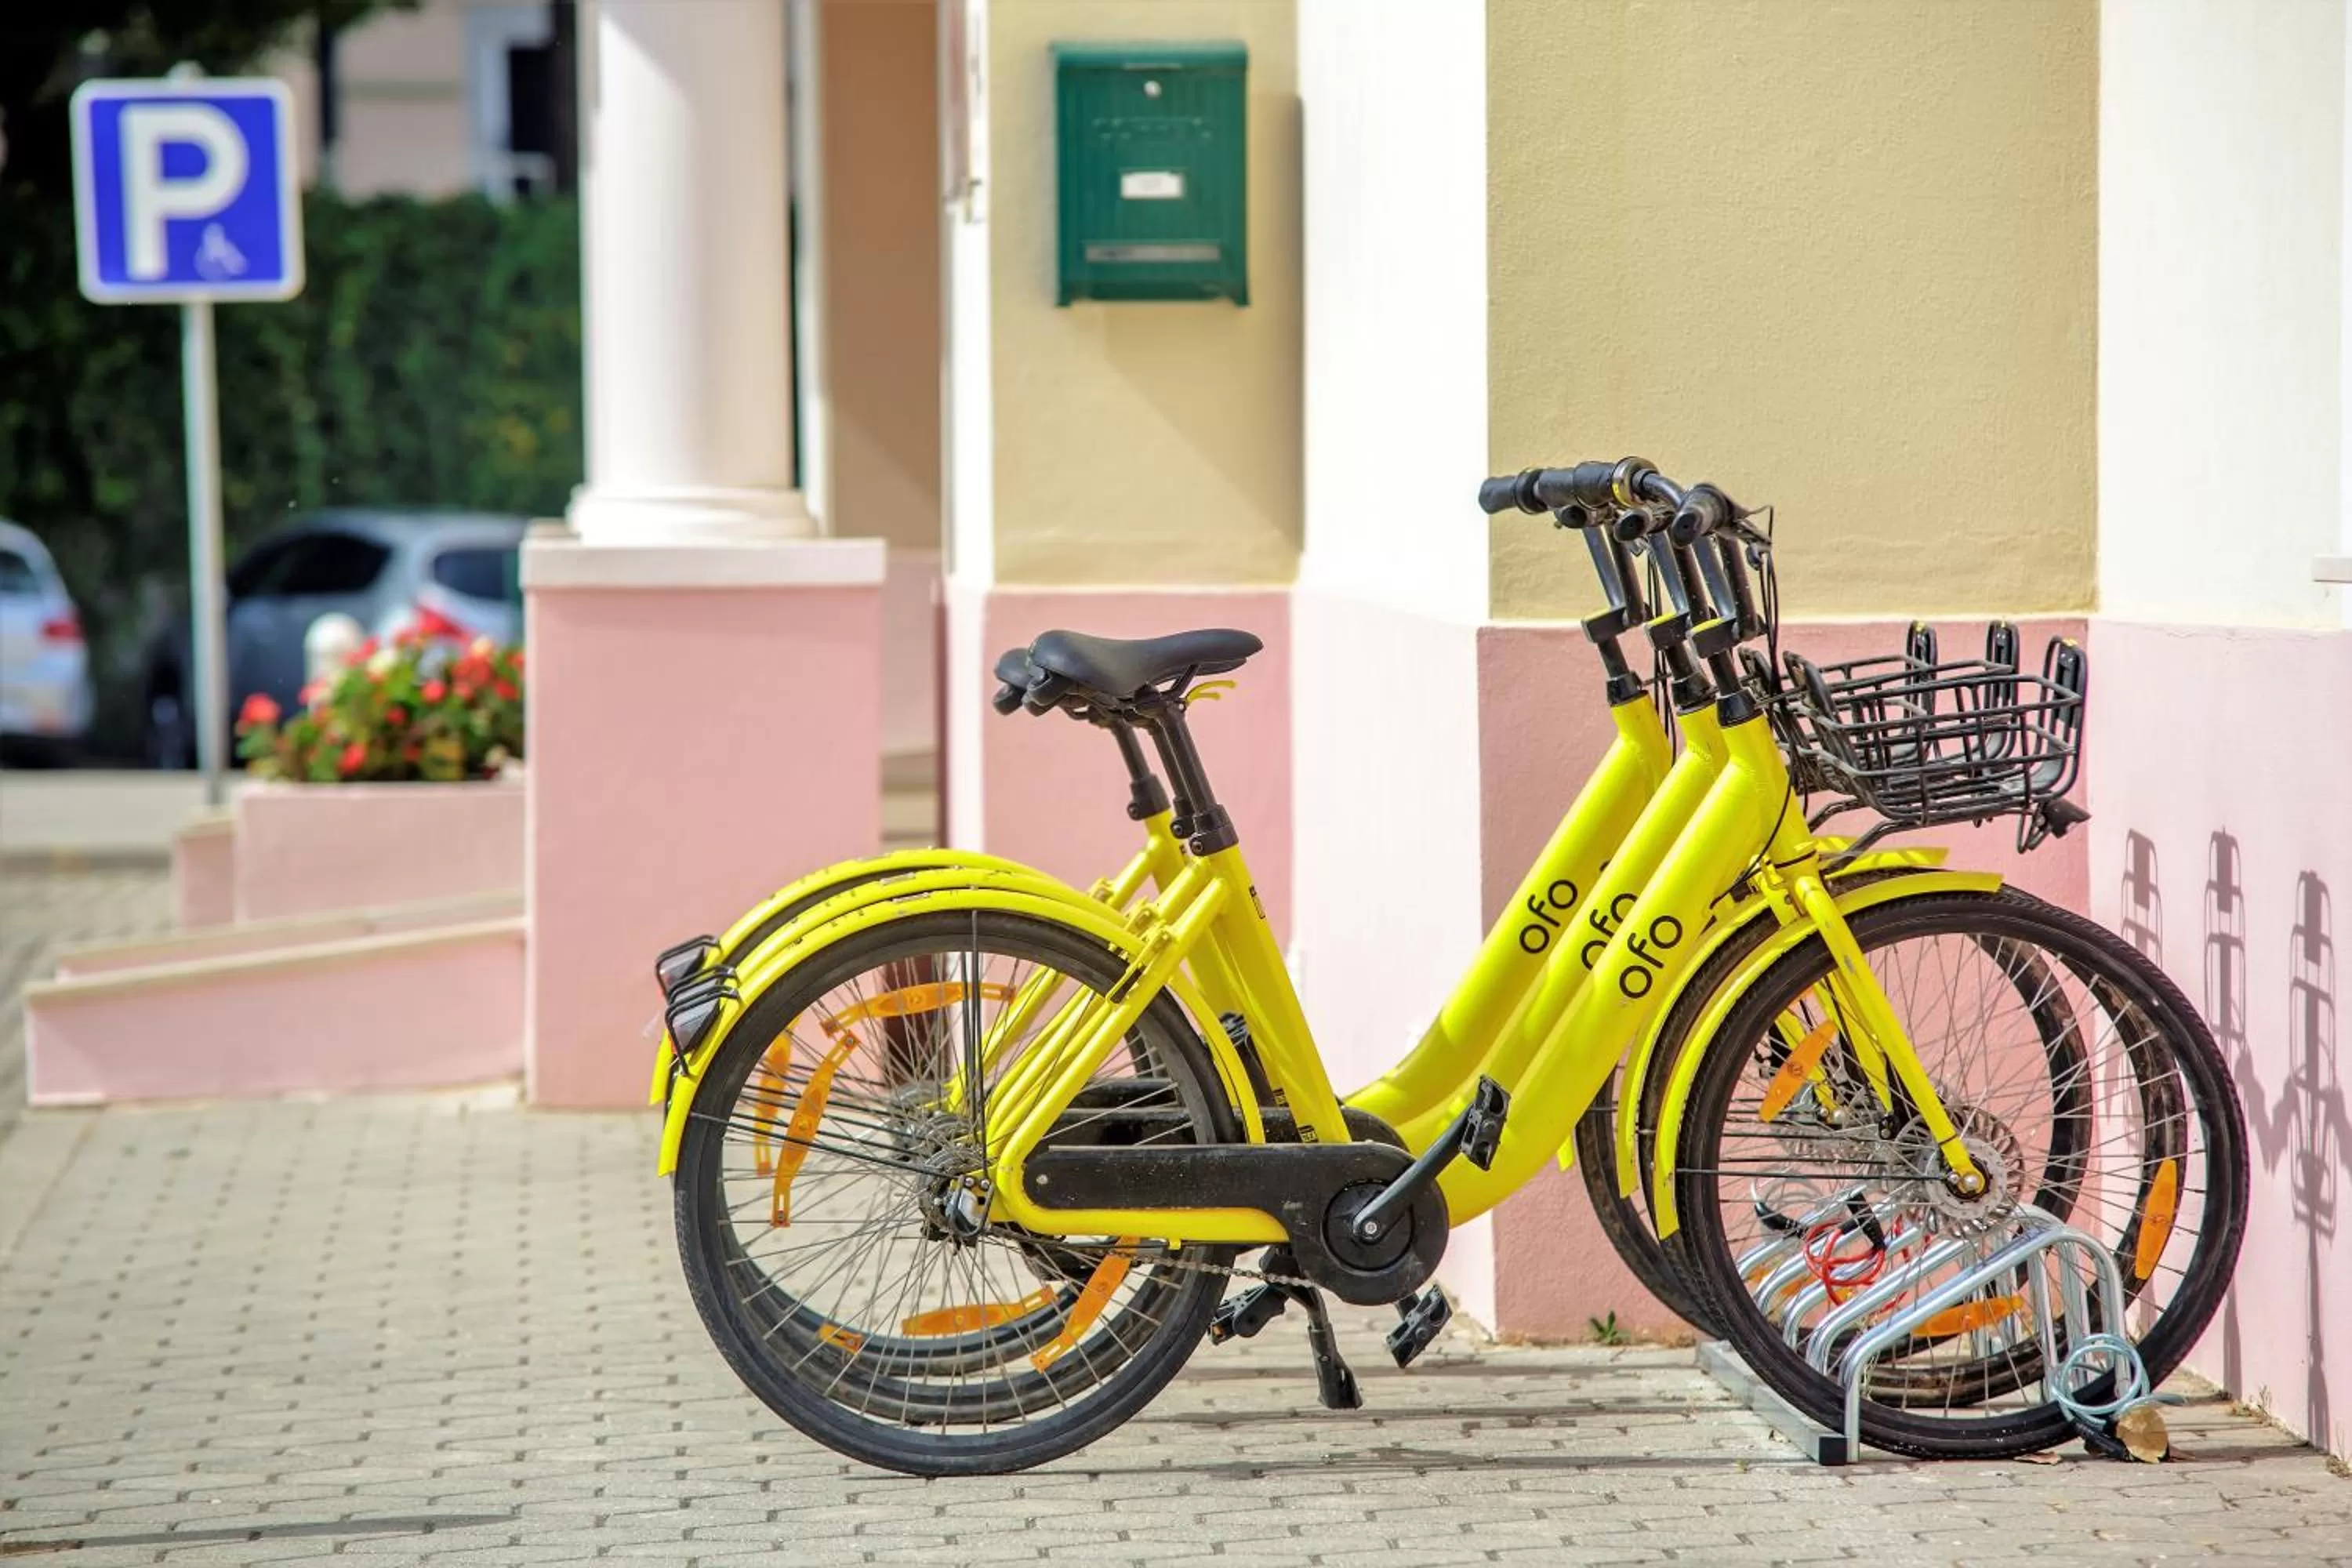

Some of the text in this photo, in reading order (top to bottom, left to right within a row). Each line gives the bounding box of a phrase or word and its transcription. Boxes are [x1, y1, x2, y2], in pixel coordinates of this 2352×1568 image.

[121, 103, 249, 280] P
[1519, 880, 1577, 953] ofo
[1619, 916, 1682, 999] ofo
